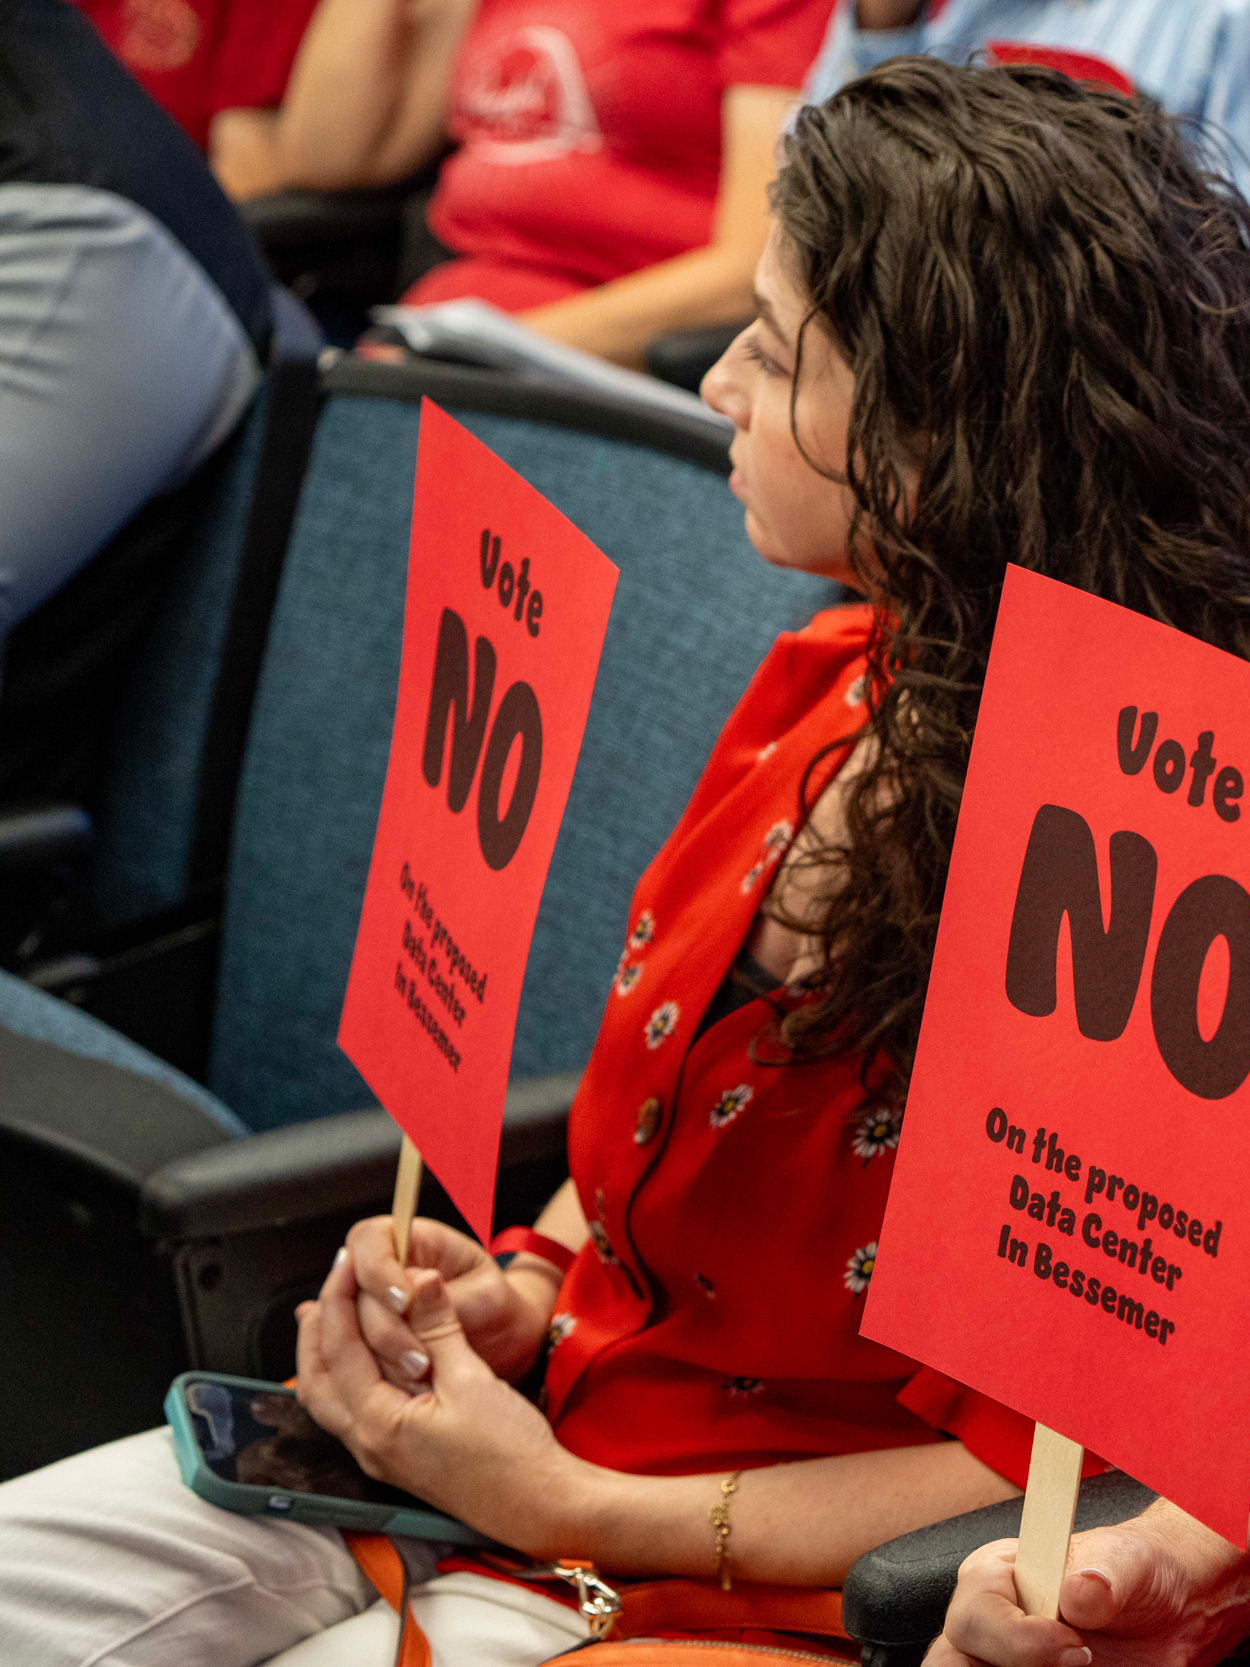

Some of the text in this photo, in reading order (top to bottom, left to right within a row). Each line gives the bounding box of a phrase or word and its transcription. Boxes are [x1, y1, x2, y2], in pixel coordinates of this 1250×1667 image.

[480, 529, 544, 638] Vote
[422, 607, 543, 872] NO
[1116, 705, 1244, 823] Vote
[400, 861, 488, 1005] On the proposed
[402, 919, 467, 1030] Data Center
[395, 961, 462, 1074] In Bessemer
[985, 1107, 1223, 1258] On the proposed
[1009, 1174, 1182, 1291] Data Center
[997, 1224, 1175, 1346] In Bessemer
